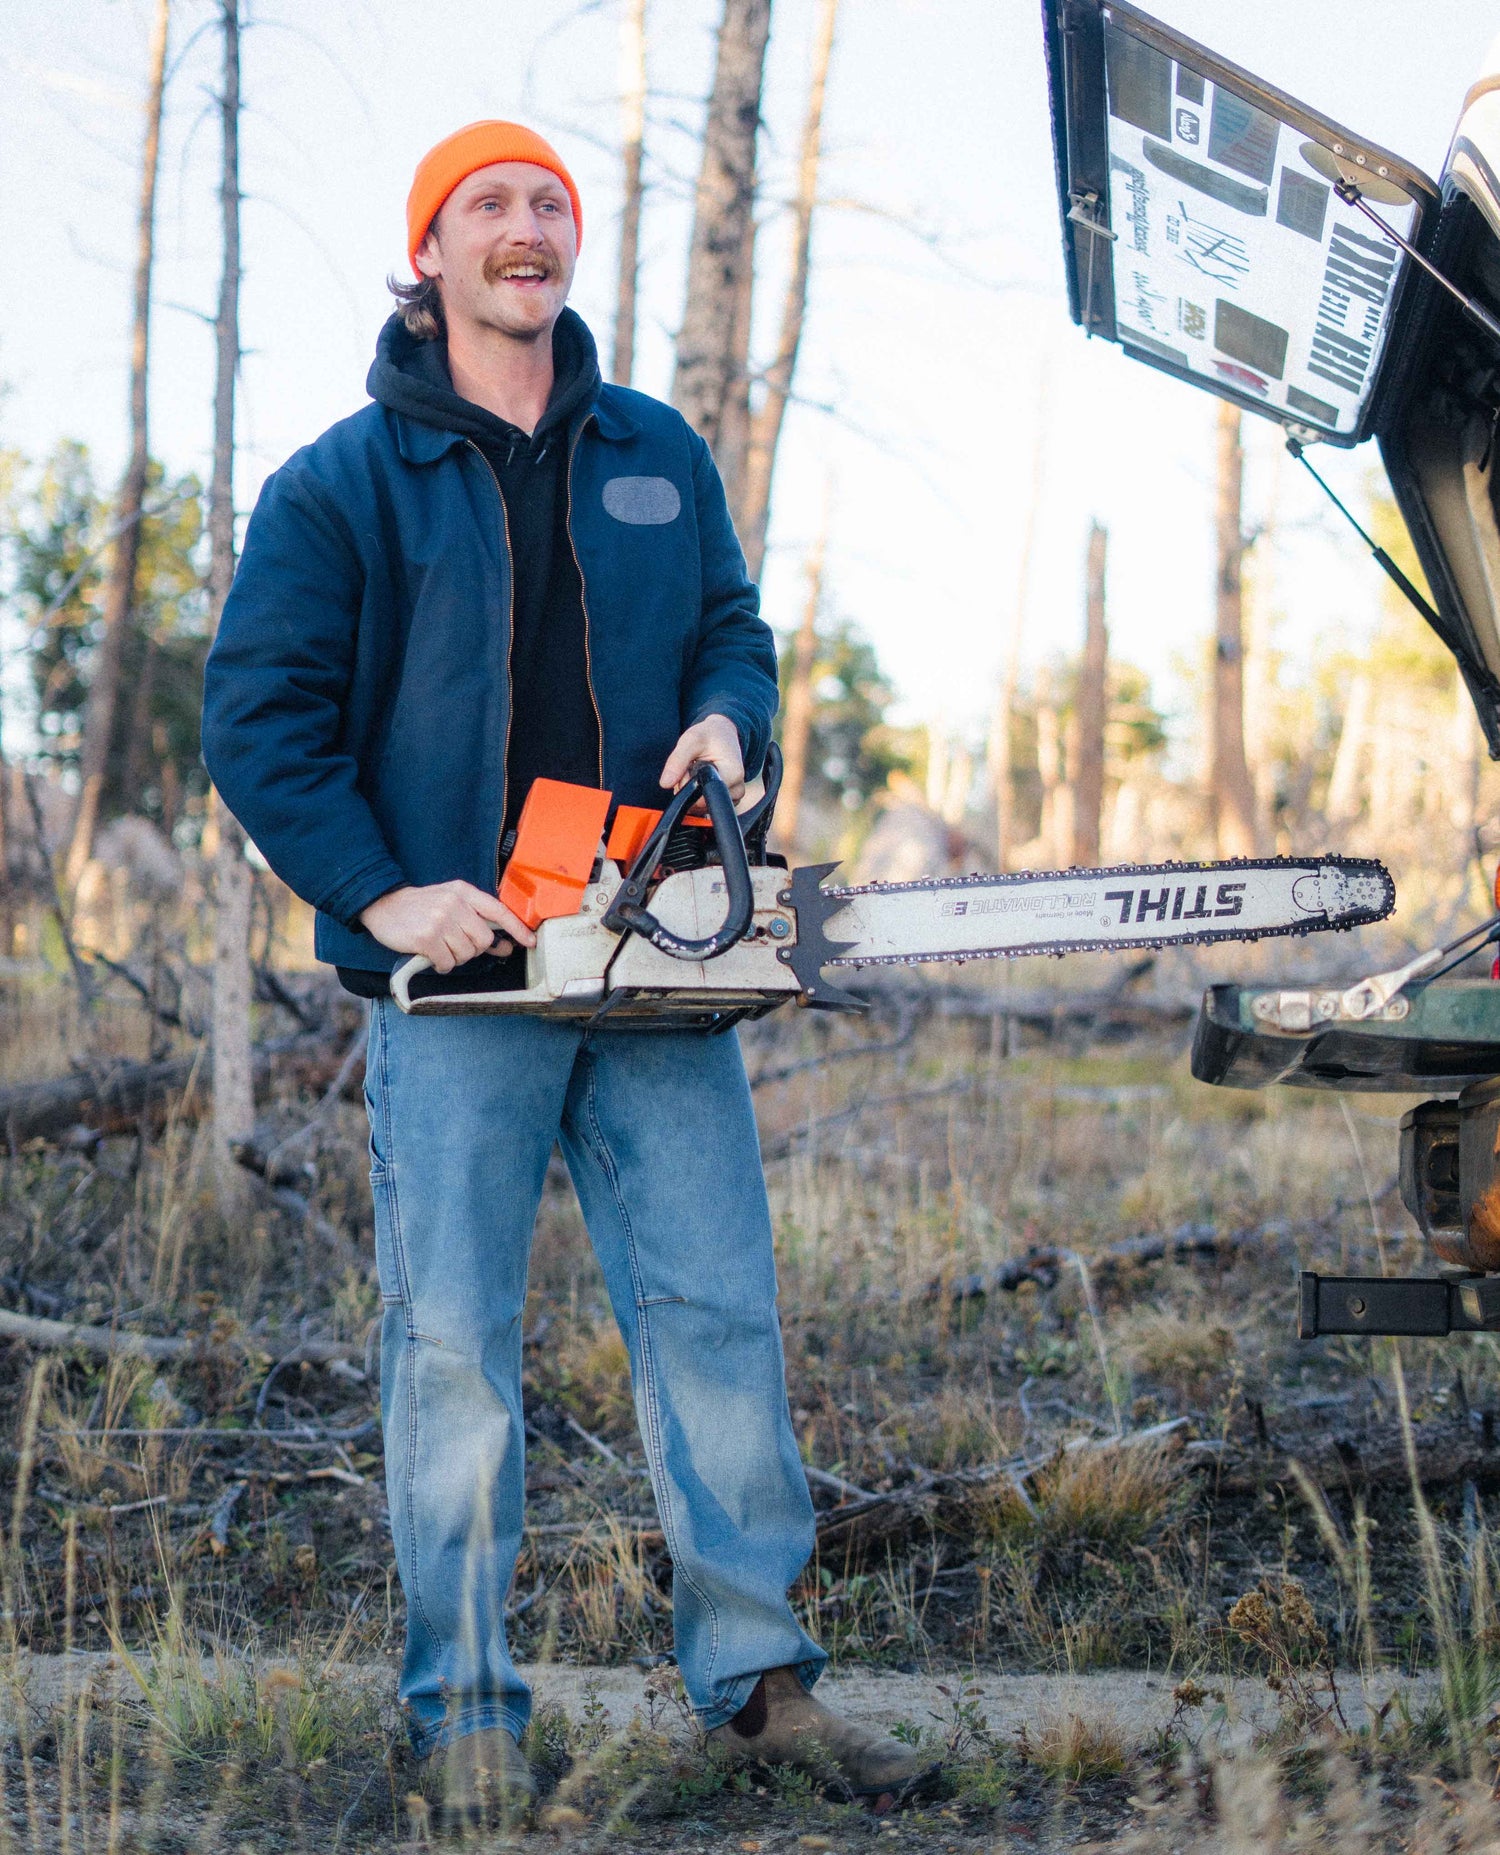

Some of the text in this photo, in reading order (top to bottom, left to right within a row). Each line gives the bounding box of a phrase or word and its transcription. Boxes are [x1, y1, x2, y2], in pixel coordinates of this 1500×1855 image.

[970, 893, 1097, 914] ROLLOMATIC
[1104, 883, 1246, 924] STIHL
[1035, 911, 1065, 919] Germany
[1075, 910, 1094, 918] Made
